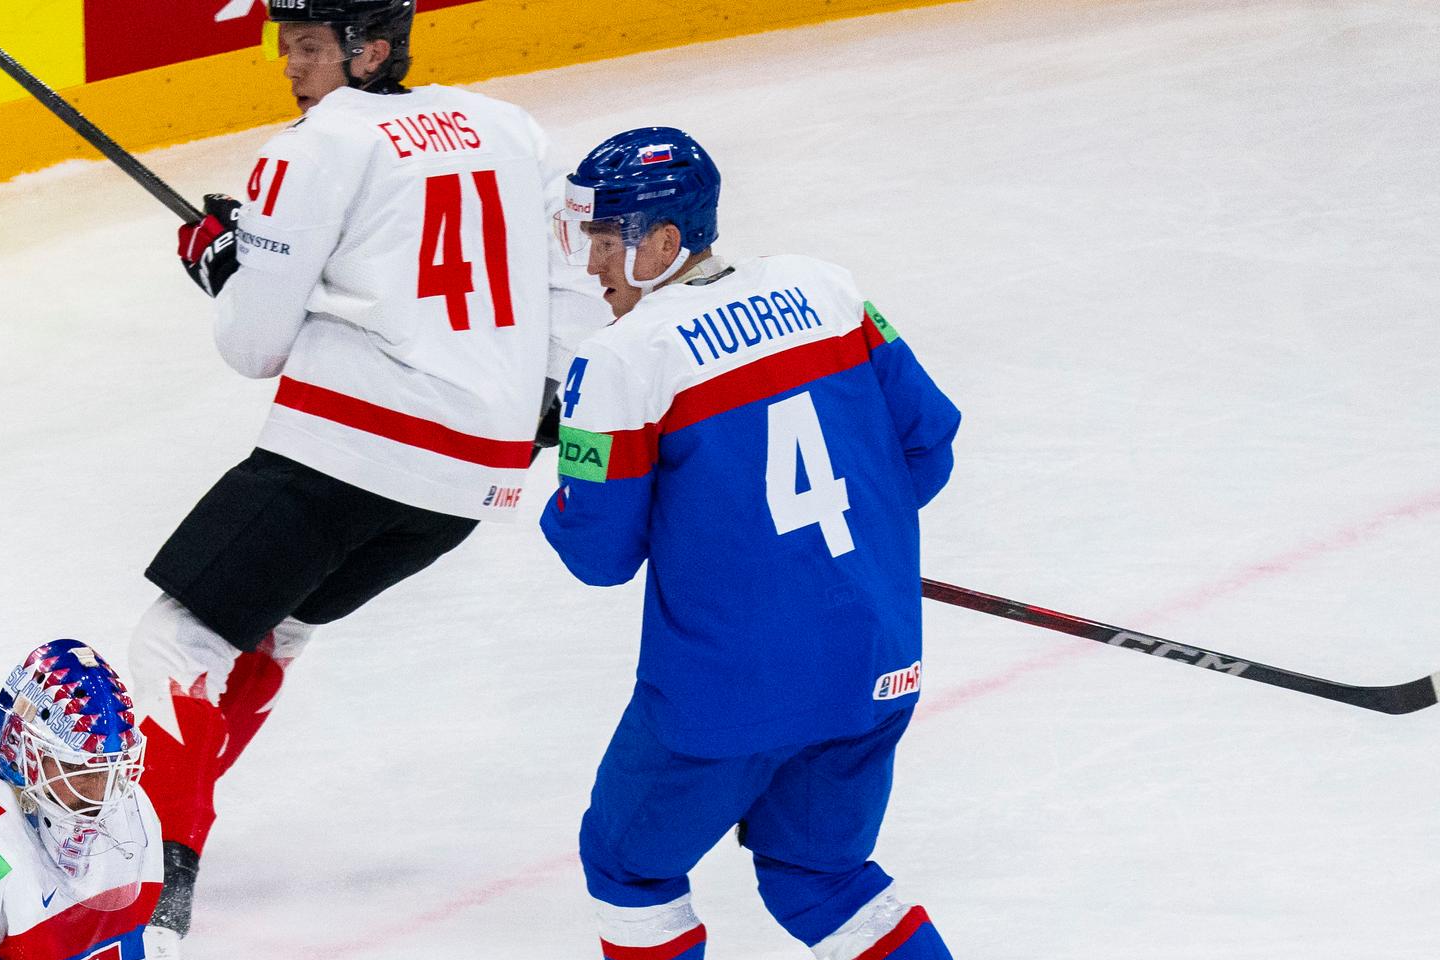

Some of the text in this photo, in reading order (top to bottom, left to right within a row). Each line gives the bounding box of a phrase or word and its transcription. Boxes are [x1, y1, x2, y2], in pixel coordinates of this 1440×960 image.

[378, 111, 481, 159] EVANS
[417, 170, 516, 331] 41
[676, 286, 823, 366] MUDRAK
[563, 356, 589, 418] 4
[765, 390, 856, 559] 4
[1108, 631, 1250, 677] CCM
